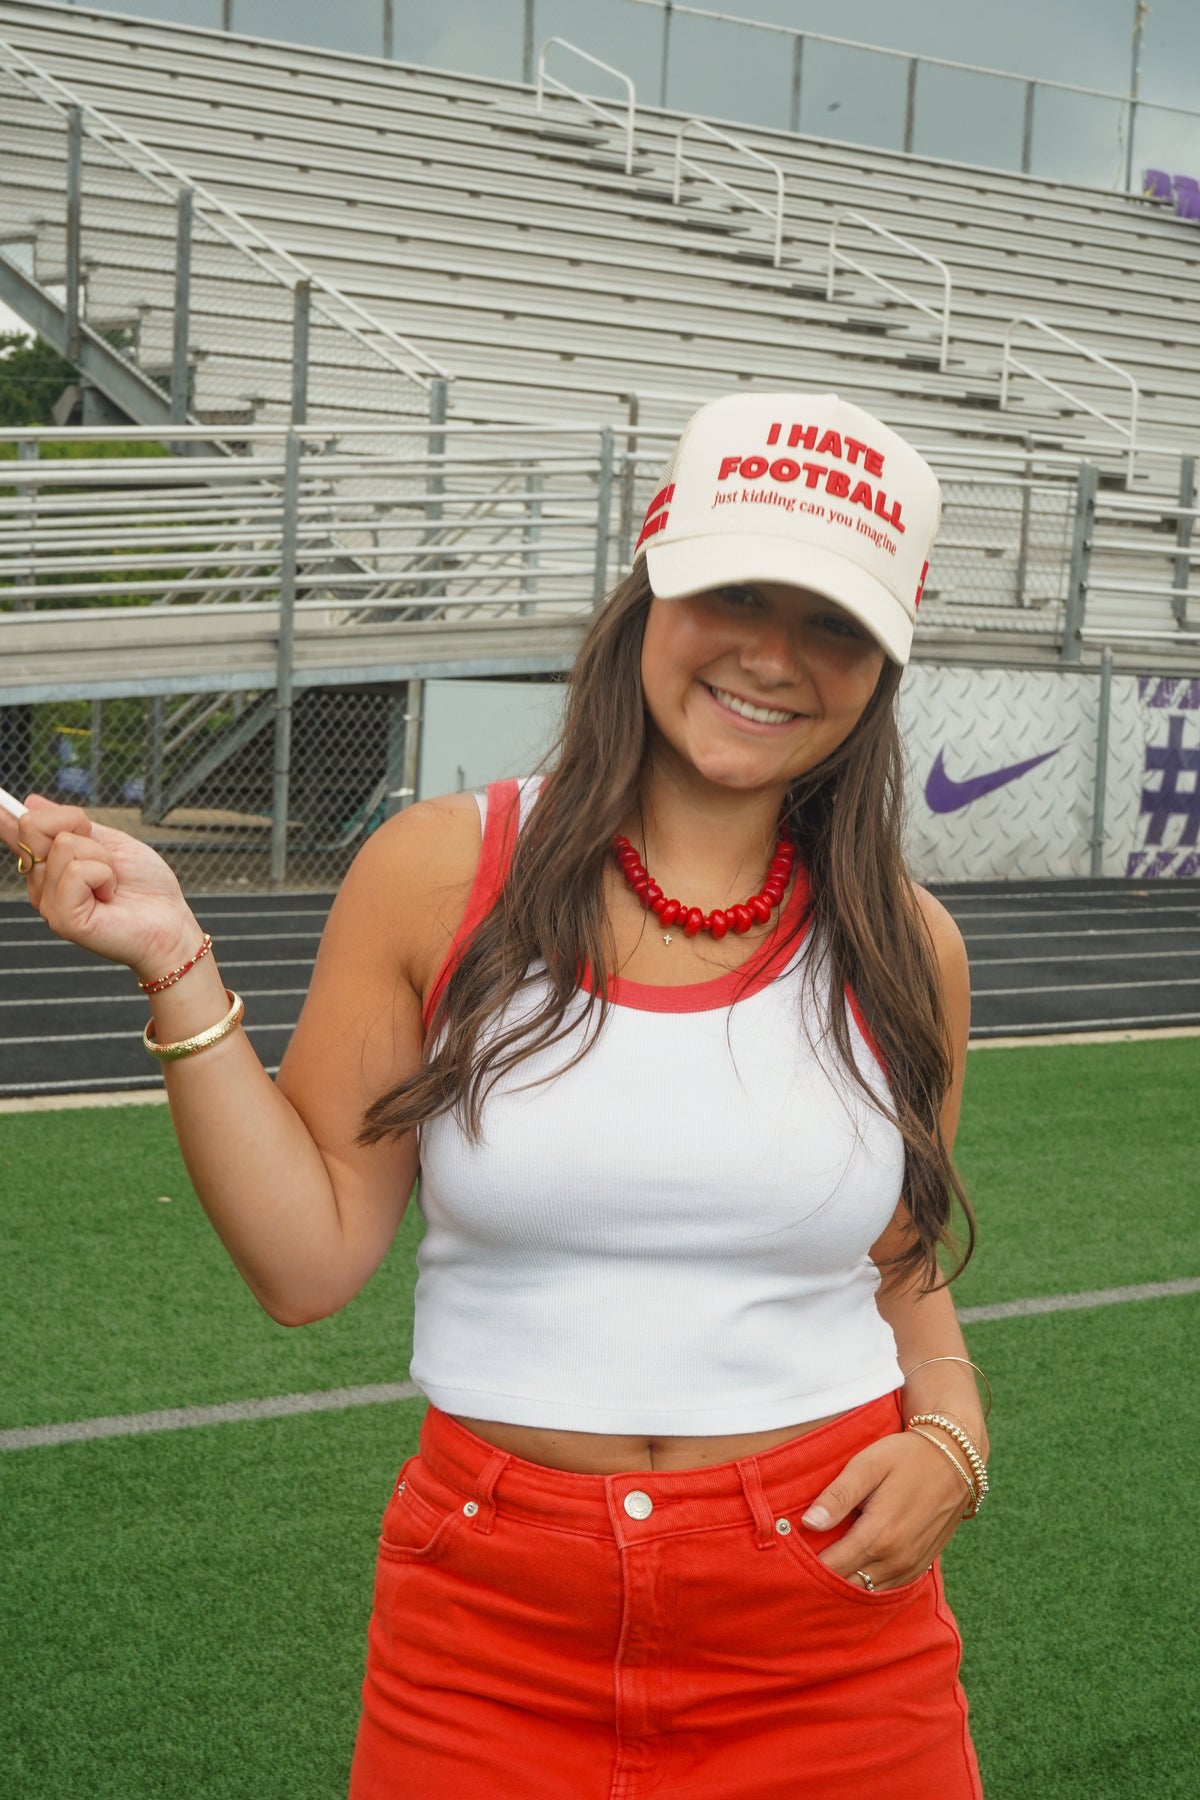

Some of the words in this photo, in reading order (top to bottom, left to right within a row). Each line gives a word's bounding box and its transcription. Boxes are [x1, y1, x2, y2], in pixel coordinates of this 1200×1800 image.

[766, 423, 782, 445] I
[787, 423, 885, 478] HATE
[712, 490, 738, 509] just
[741, 489, 796, 512] kidding
[800, 502, 825, 517] can
[828, 509, 853, 528] you
[856, 517, 897, 556] imagine
[718, 455, 906, 533] FOOTBALL
